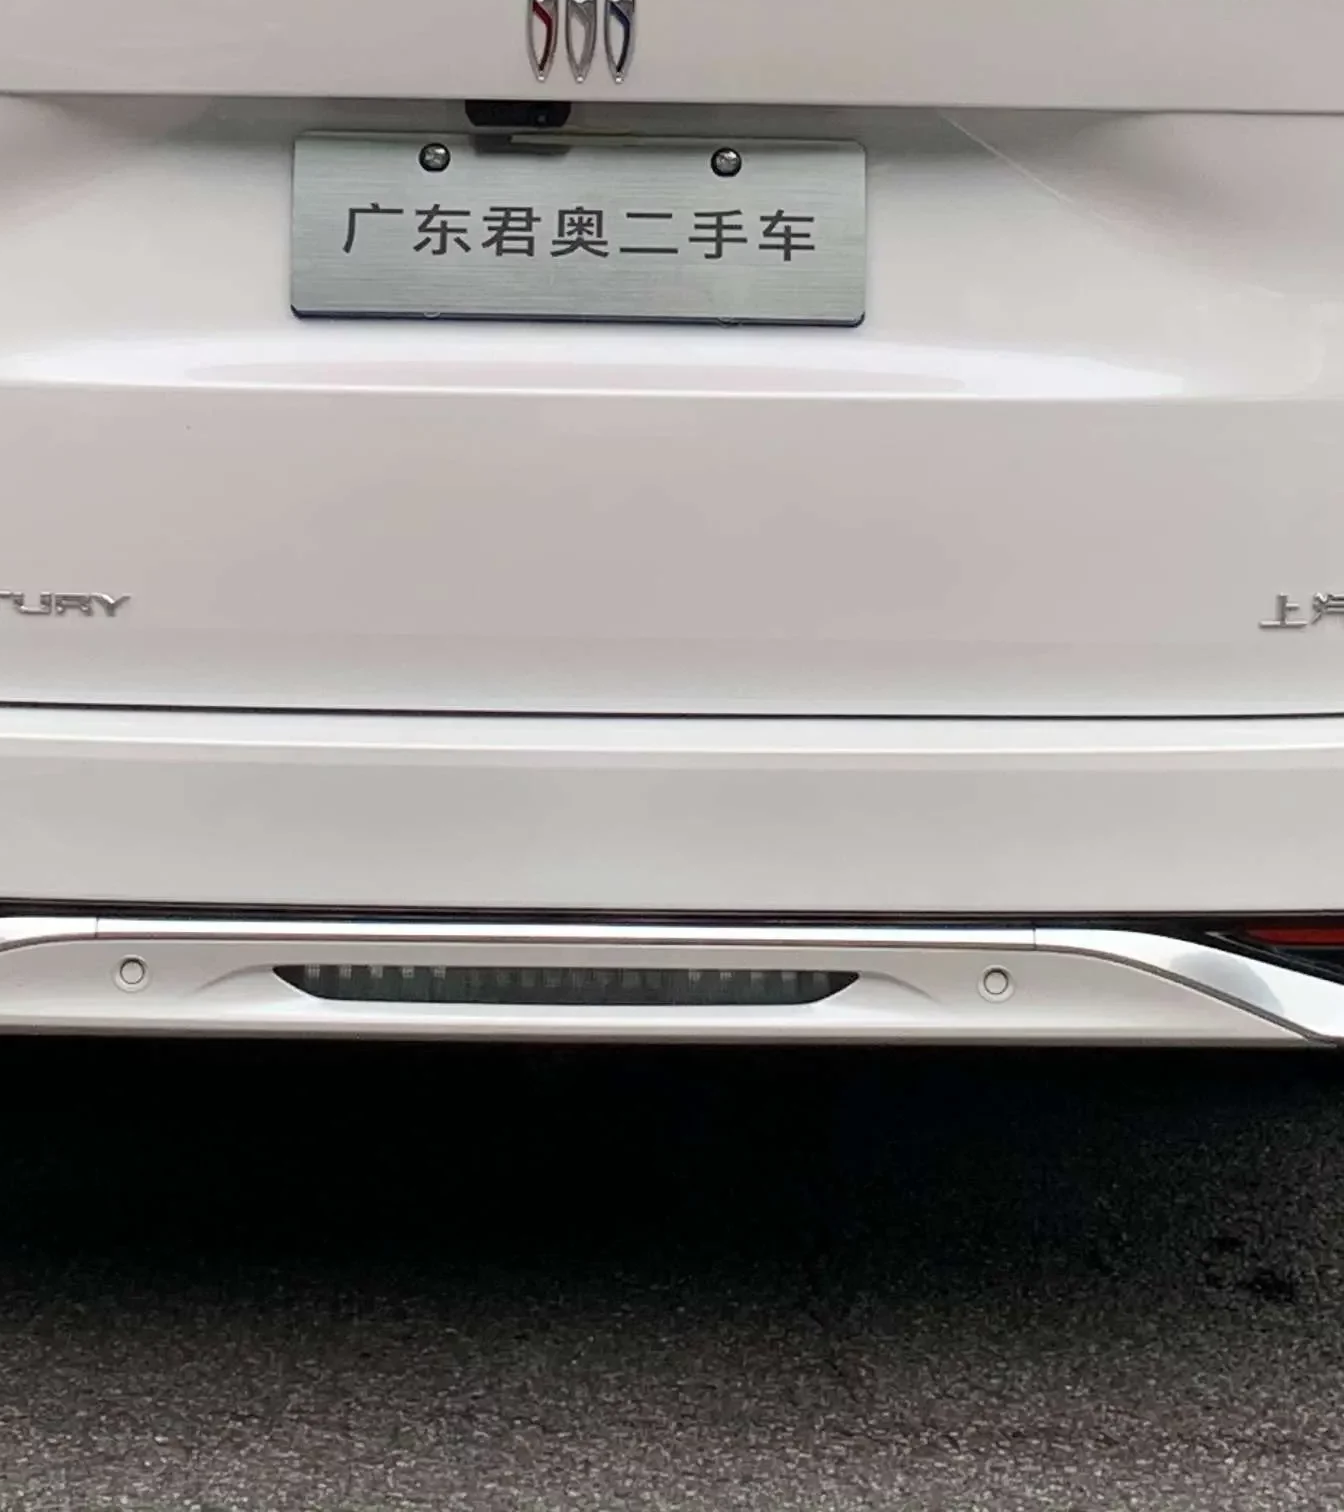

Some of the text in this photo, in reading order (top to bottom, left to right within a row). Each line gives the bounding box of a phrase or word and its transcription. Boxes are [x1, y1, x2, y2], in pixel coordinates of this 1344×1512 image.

[341, 202, 818, 262] 广东君奥二手车
